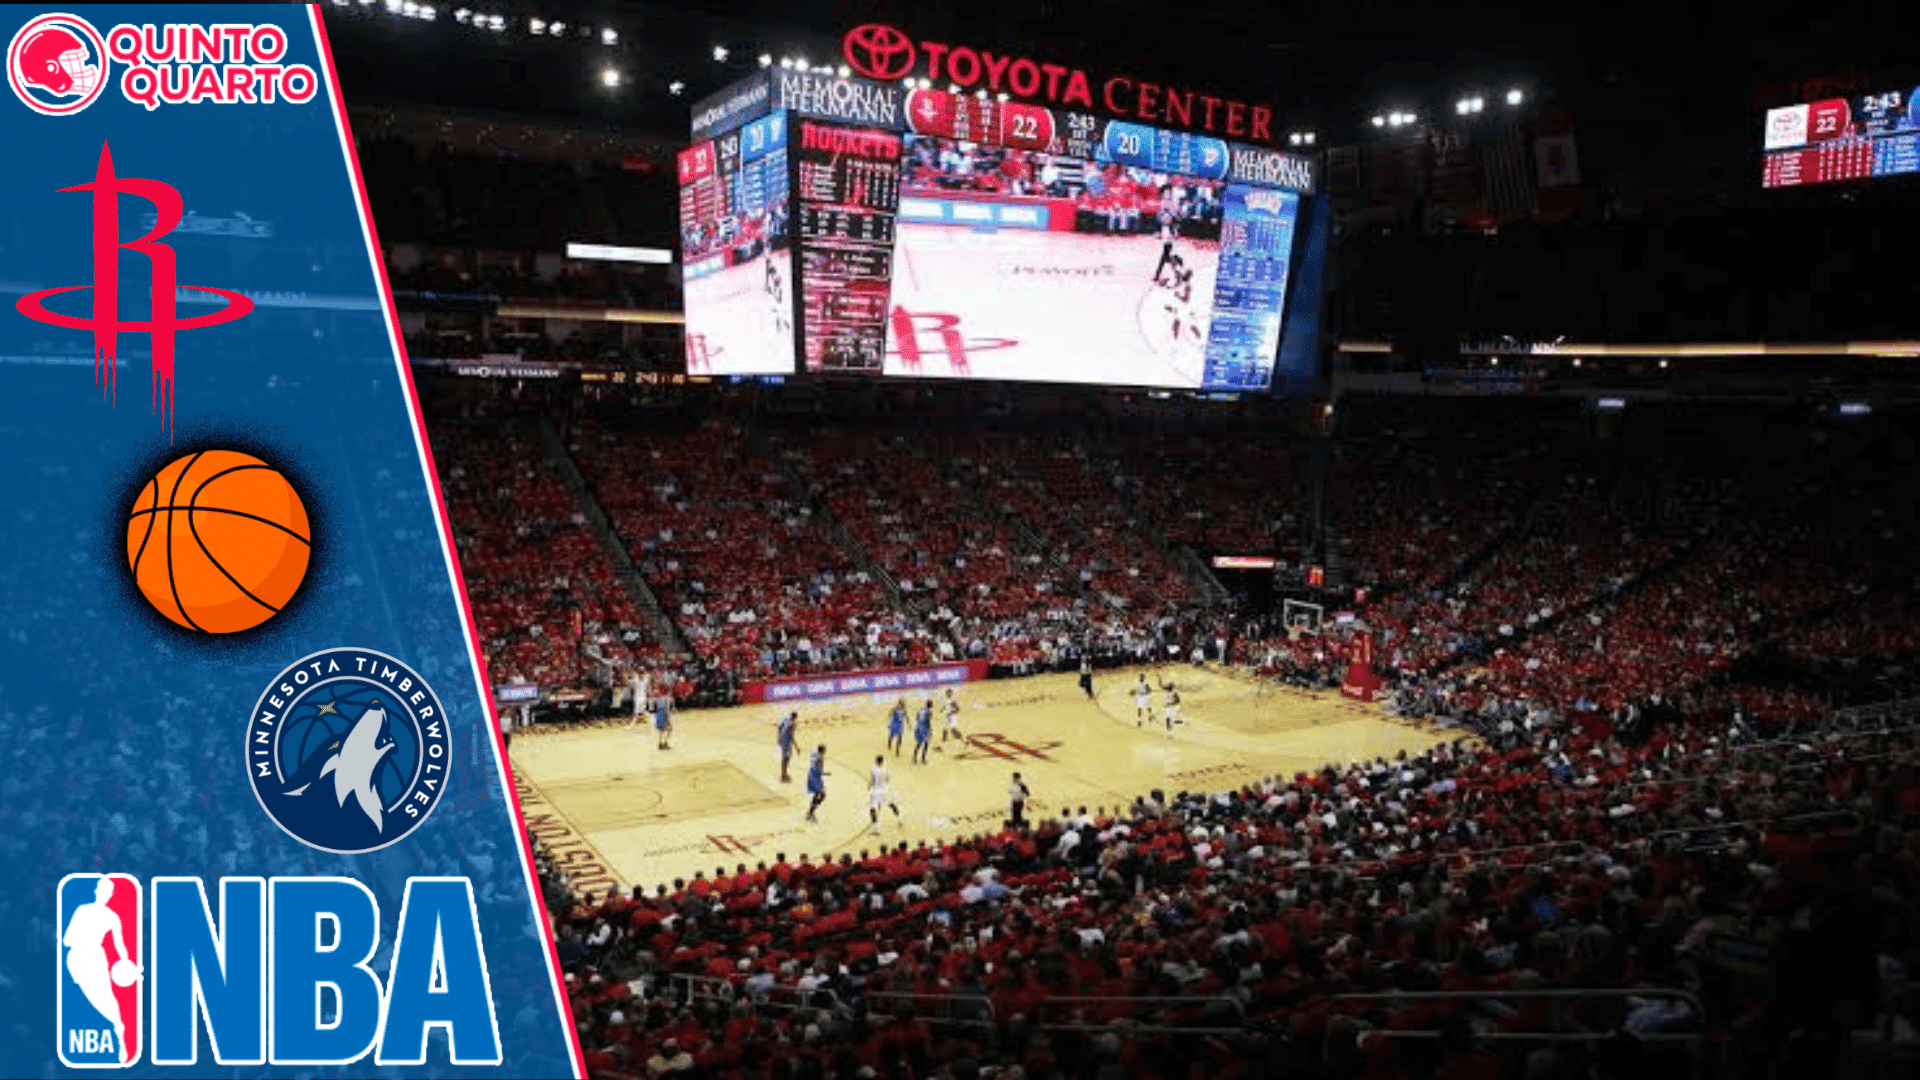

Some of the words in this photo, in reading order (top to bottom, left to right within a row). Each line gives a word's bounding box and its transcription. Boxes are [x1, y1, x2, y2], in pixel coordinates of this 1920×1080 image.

[780, 73, 897, 105] MEMORIAL
[921, 41, 1092, 107] TOYOTA
[1104, 77, 1273, 142] CENTER
[780, 93, 897, 124] HERMANN
[1863, 91, 1902, 113] 2:43
[1012, 113, 1039, 140] 22
[1067, 112, 1096, 131] 2:43
[1816, 116, 1837, 133] 22
[1118, 132, 1140, 155] 20
